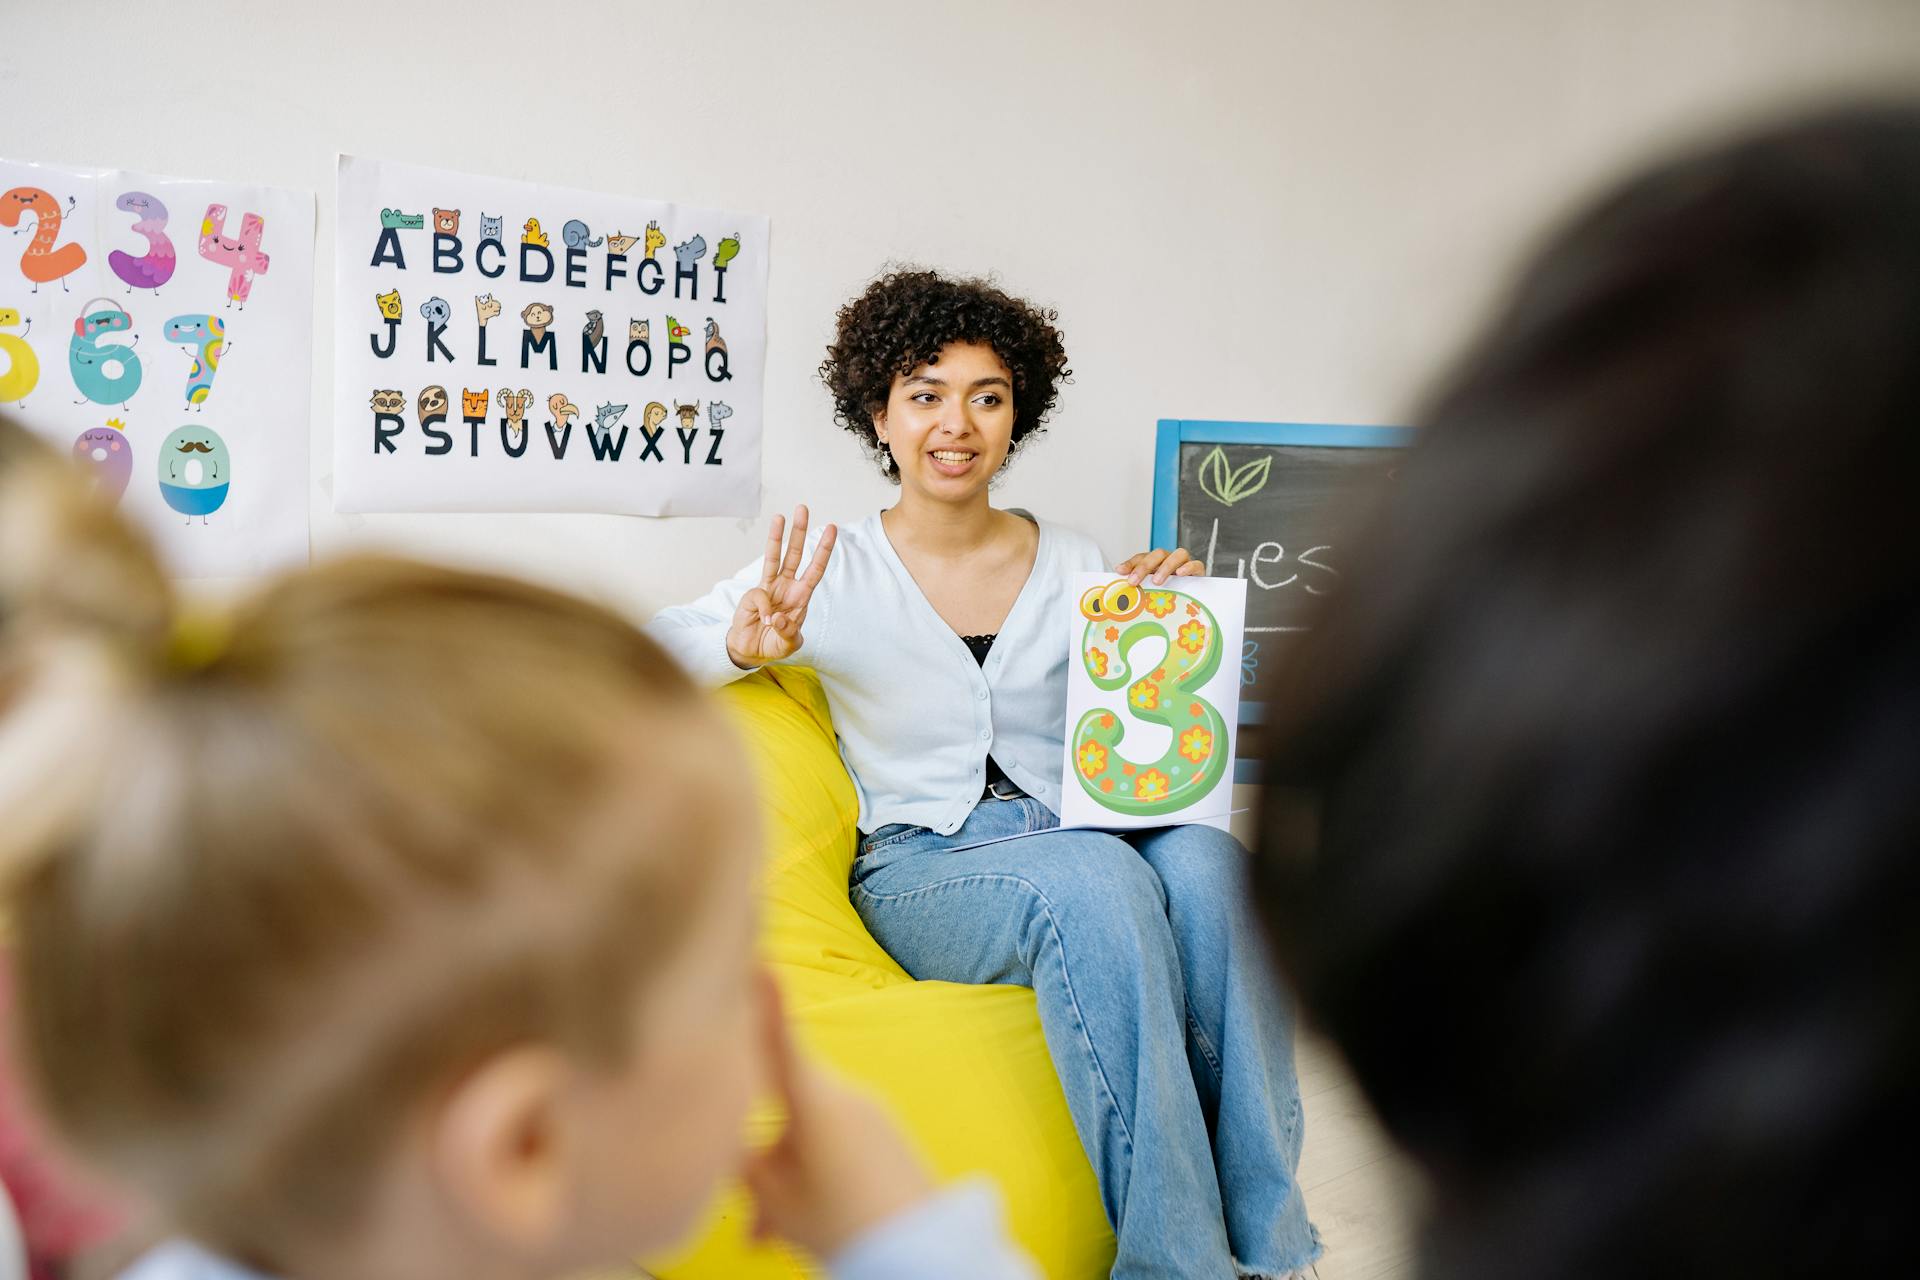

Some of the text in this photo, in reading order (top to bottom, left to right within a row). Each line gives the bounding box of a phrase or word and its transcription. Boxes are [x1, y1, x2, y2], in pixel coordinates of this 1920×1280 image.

[0, 187, 270, 301] 2 3 4
[371, 227, 728, 304] A B C D E F G H I
[69, 310, 142, 405] 6
[164, 314, 225, 404] 7
[370, 318, 733, 383] J K L M N O P Q
[158, 424, 230, 516] 0
[374, 412, 725, 466] R S T U V W X Y Z
[1072, 588, 1229, 816] 3
